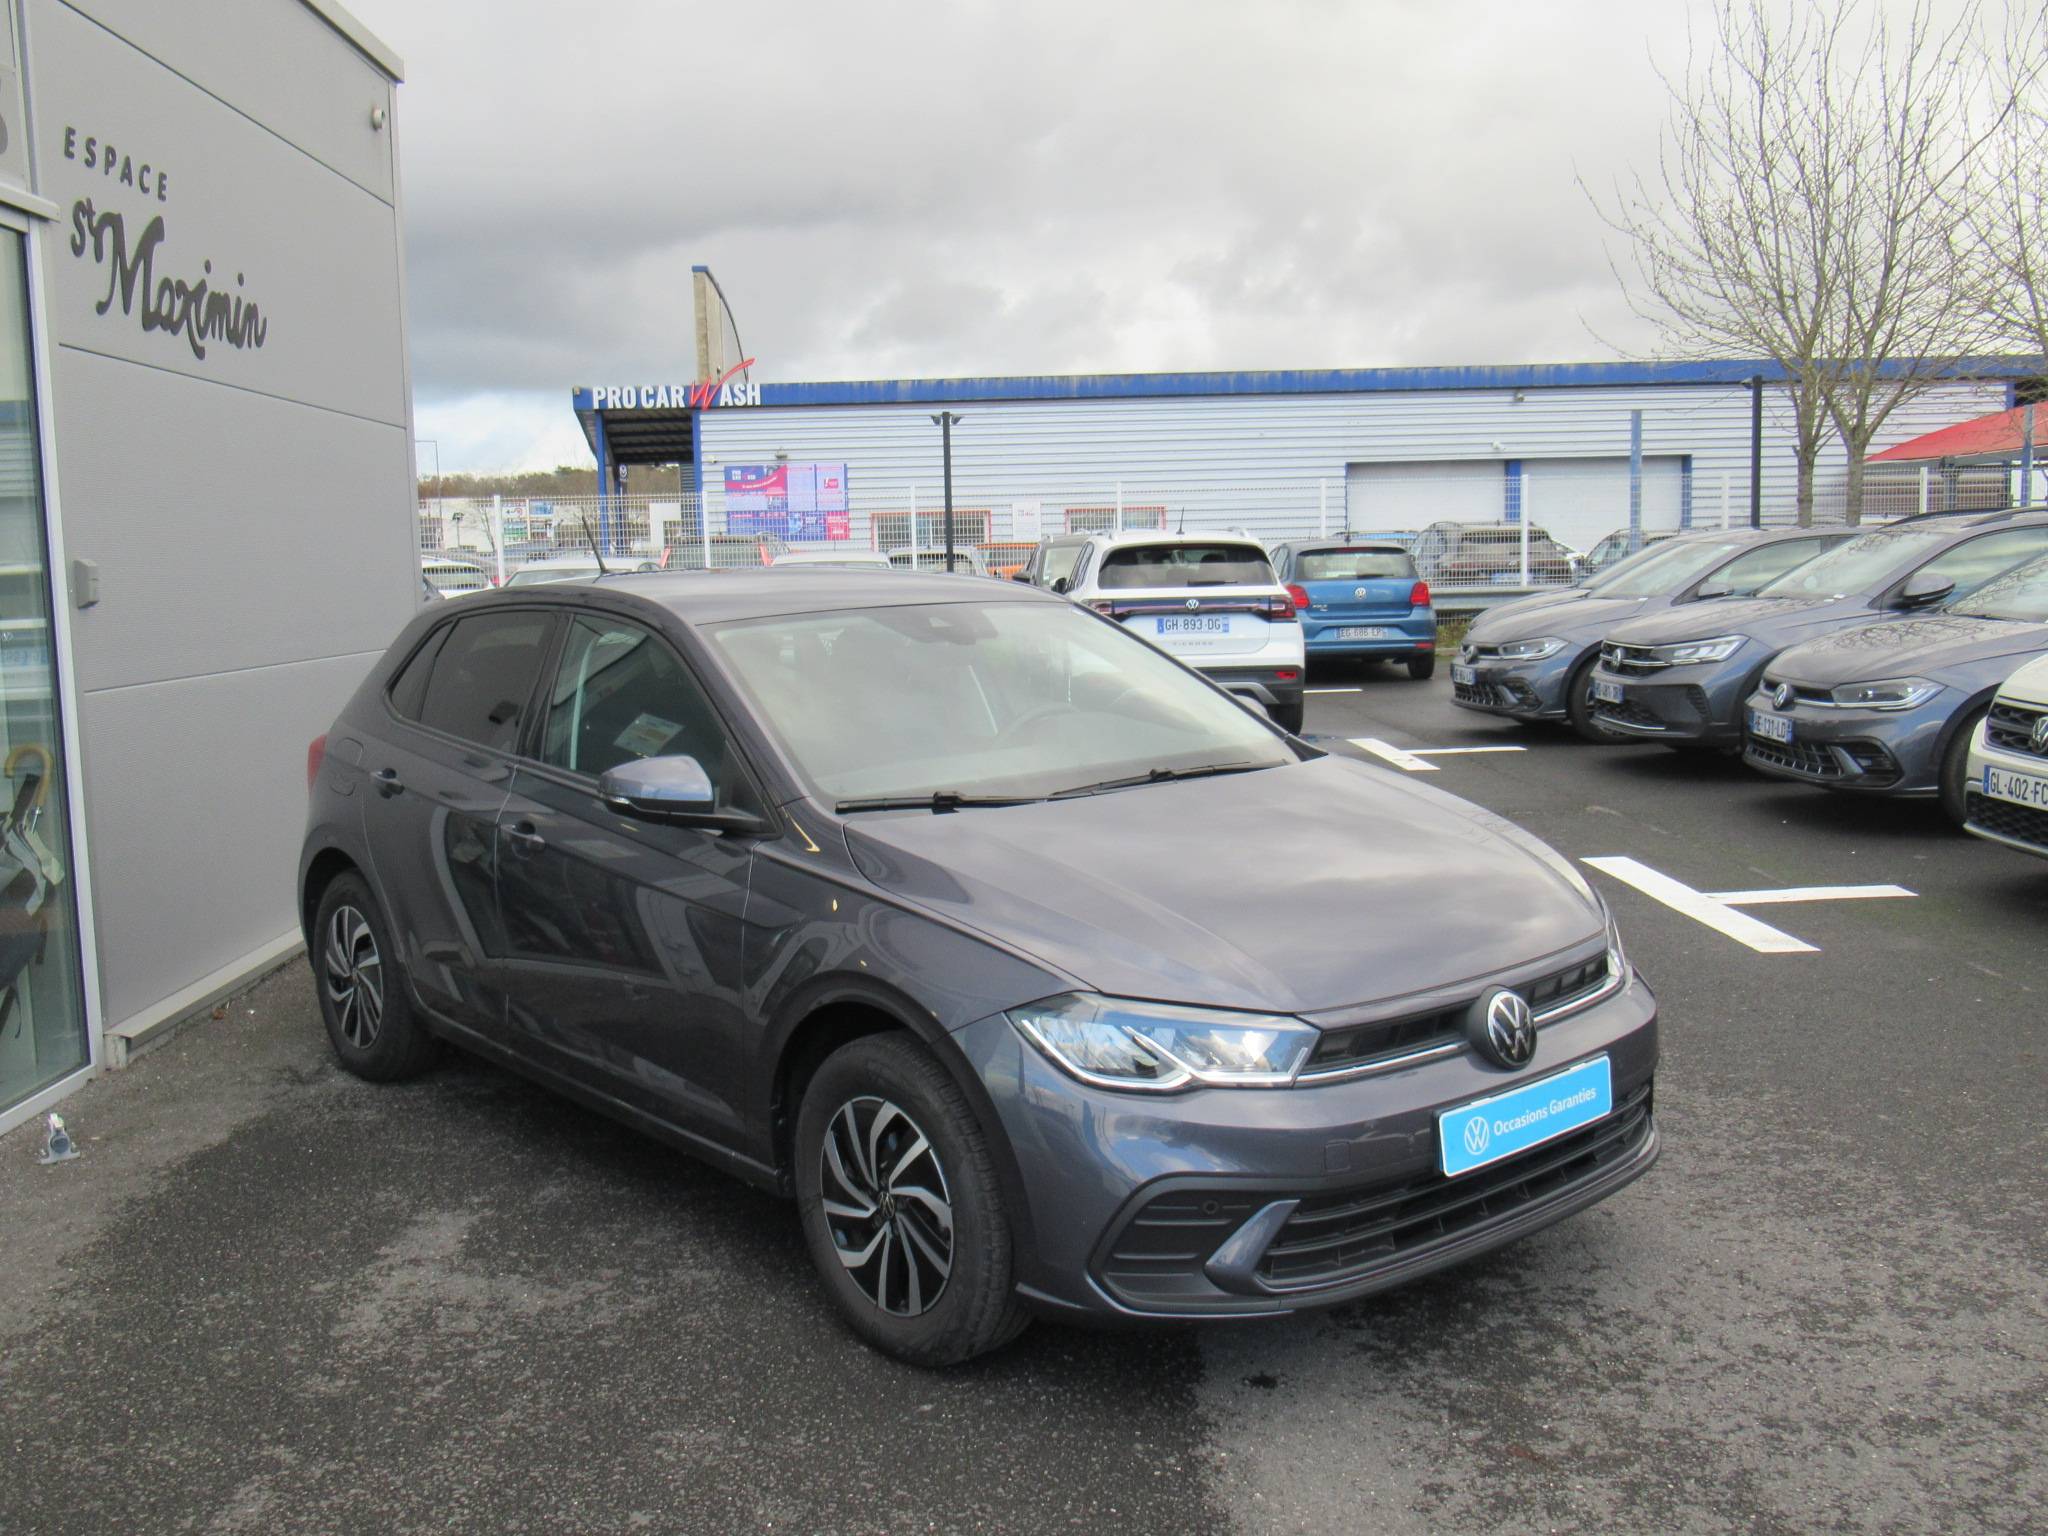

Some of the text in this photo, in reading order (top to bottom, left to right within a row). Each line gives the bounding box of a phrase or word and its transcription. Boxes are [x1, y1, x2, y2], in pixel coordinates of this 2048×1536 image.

[64, 126, 168, 202] ESPACE
[93, 212, 268, 360] Maximin
[592, 358, 761, 411] PRO CAR WASH
[1493, 1107, 1549, 1136] Occasions
[1549, 1087, 1597, 1115] Garanties
